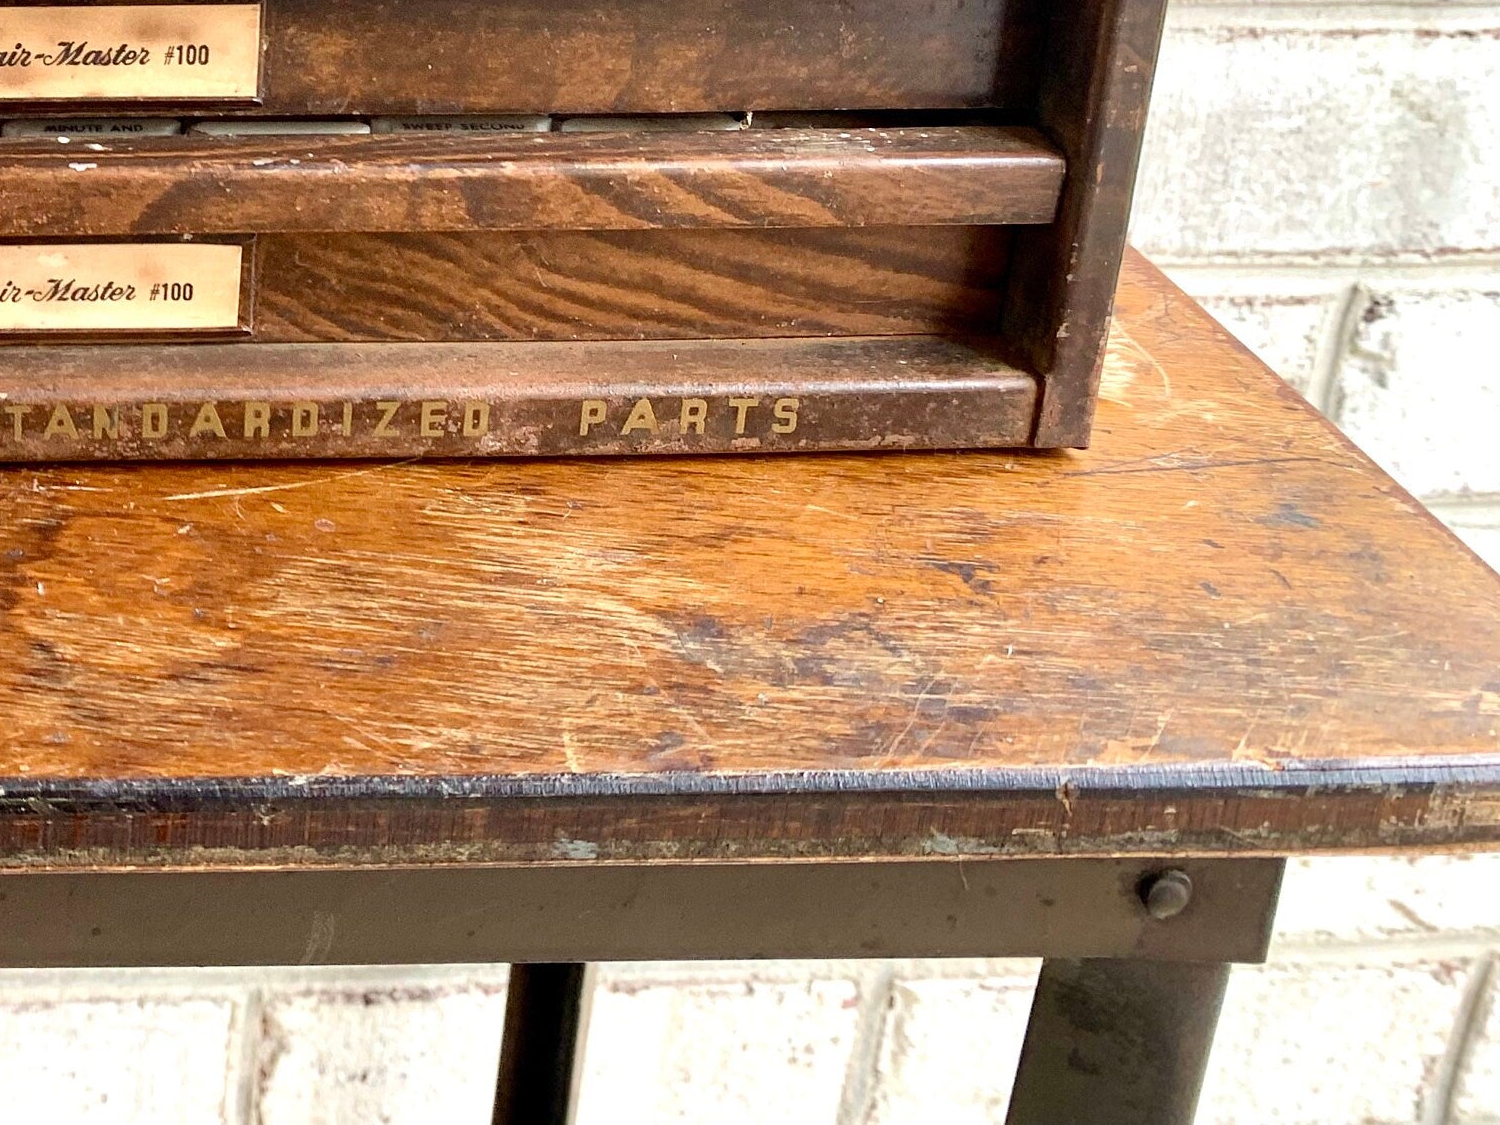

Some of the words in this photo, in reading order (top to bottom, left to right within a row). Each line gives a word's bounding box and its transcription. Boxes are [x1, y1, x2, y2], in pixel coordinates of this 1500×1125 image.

[163, 44, 211, 66] #100
[110, 123, 144, 132] AND
[150, 281, 195, 302] #100
[577, 396, 801, 436] PARTS
